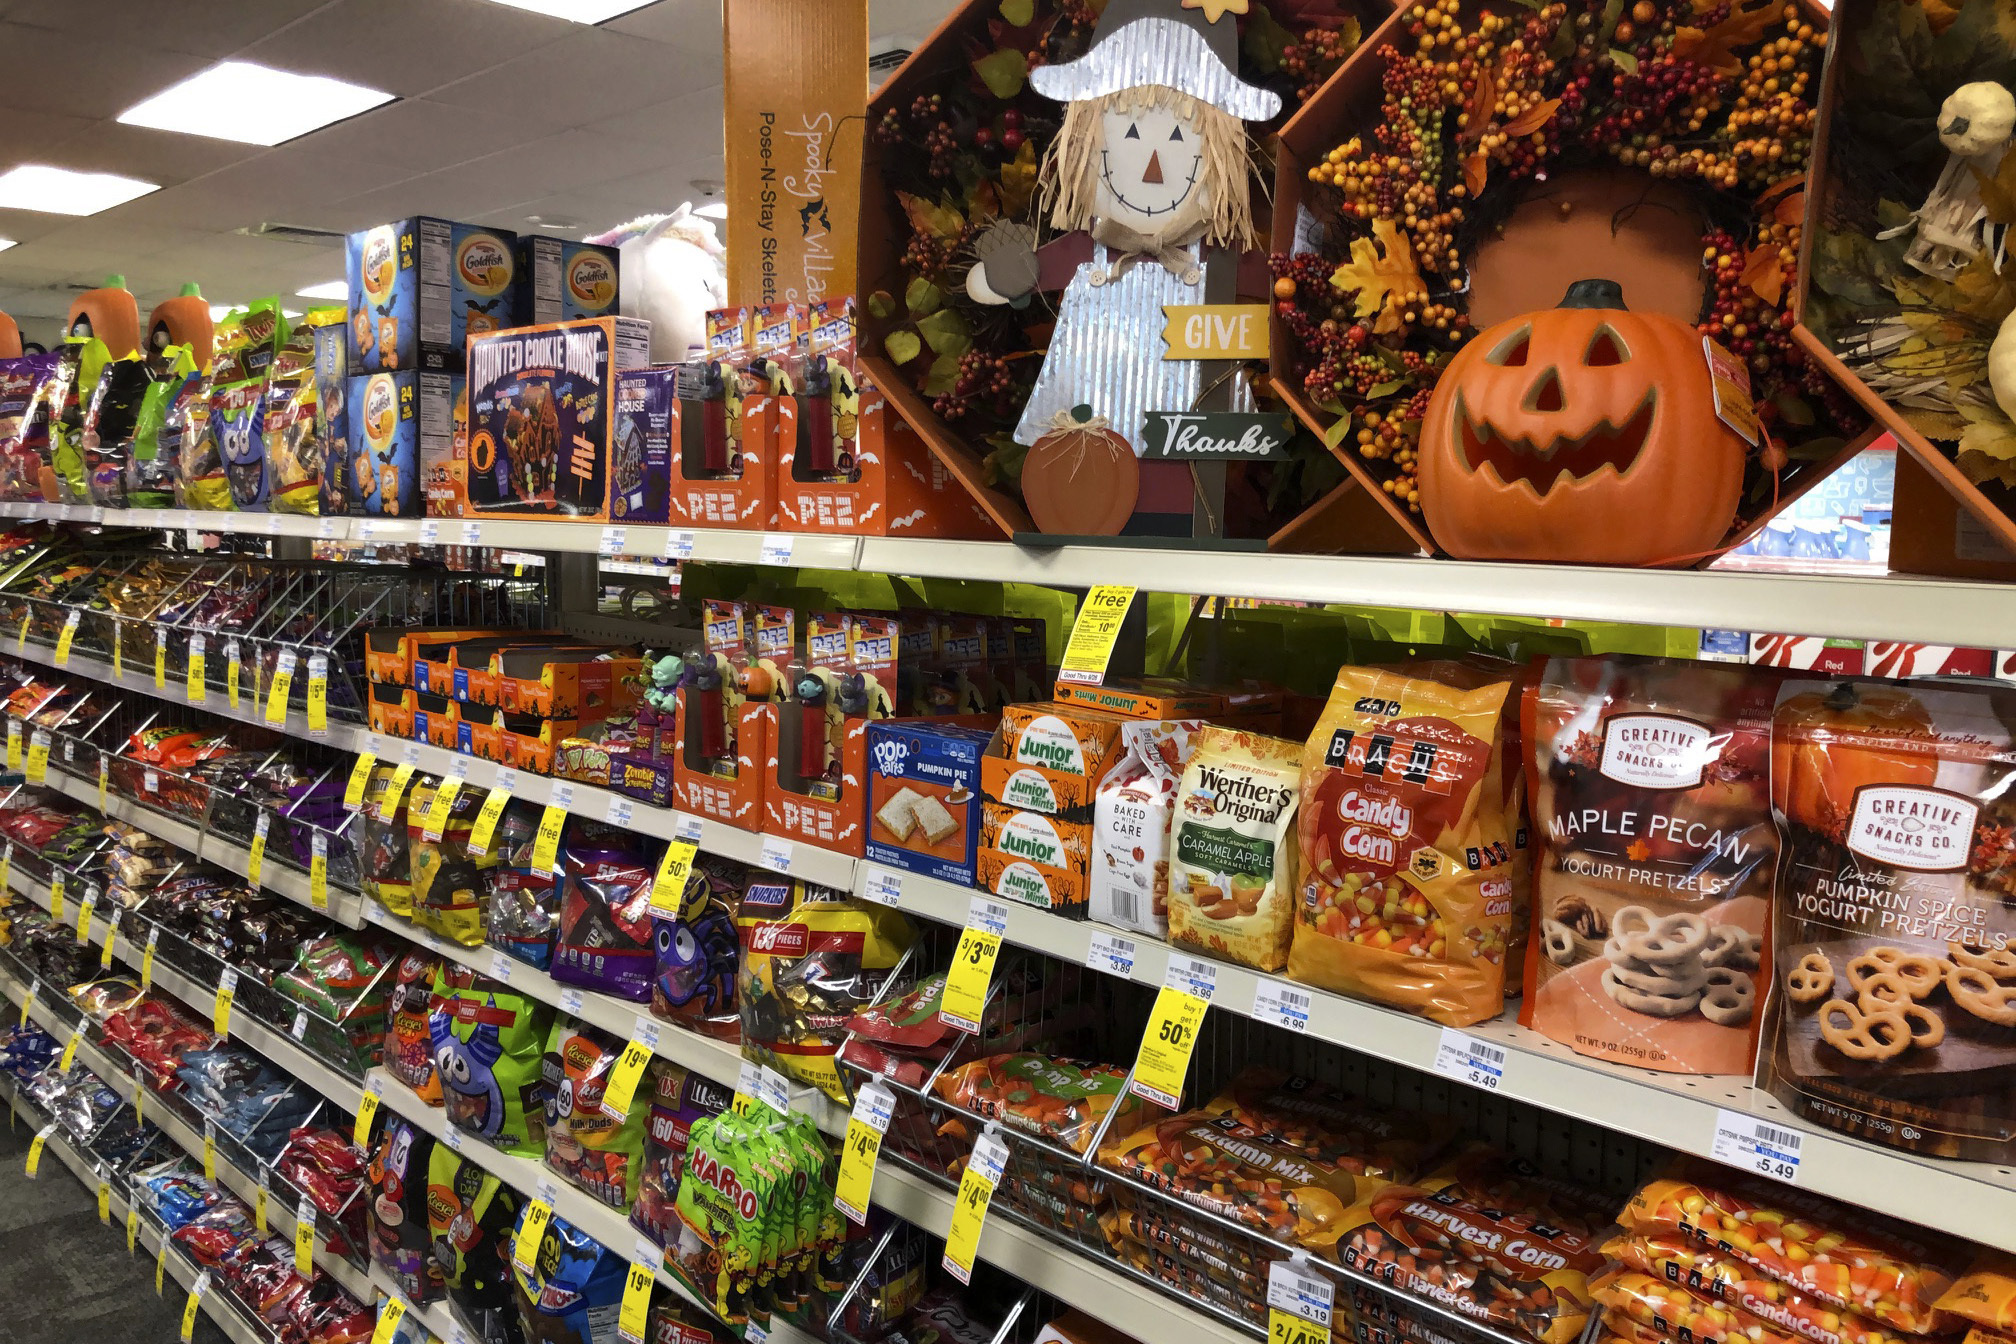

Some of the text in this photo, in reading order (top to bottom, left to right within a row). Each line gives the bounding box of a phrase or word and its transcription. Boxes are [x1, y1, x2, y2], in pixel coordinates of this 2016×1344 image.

[757, 111, 778, 232] Pose-N-Stay
[400, 234, 414, 251] 24
[465, 253, 504, 271] Goldfish
[1184, 313, 1254, 350] GIVE
[474, 332, 602, 402] HAUNTED COOKIE HOUSE
[400, 386, 414, 402] 24
[619, 378, 647, 389] HAUNTED
[618, 400, 645, 413] HOUSE
[1160, 414, 1280, 456] Thanks
[686, 490, 738, 522] PEZ
[797, 492, 855, 527] PEZ
[1092, 590, 1127, 607] free
[706, 619, 738, 642] PEZ
[756, 625, 789, 647] PEZ
[810, 632, 847, 654] PEZ
[853, 636, 892, 660] PEZ
[1825, 659, 1844, 671] Red
[1620, 728, 1696, 749] CREATIVE
[1019, 734, 1074, 766] Junior
[624, 764, 655, 783] Zombie
[916, 762, 968, 780] PUMPKIN PIE
[1010, 779, 1056, 812] Junior Mints
[1198, 763, 1292, 808] Werther's
[1364, 782, 1390, 796] Classic
[436, 790, 452, 806] free
[688, 780, 733, 819] PEZ
[1212, 793, 1283, 825] Original
[481, 804, 498, 820] free
[782, 800, 836, 841] PEZ
[1113, 804, 1146, 820] BAKED
[1120, 816, 1136, 824] WITH
[1340, 792, 1412, 836] Candy
[1872, 798, 1962, 826] CREATIVE
[539, 822, 558, 841] free
[1112, 821, 1142, 838] CARE
[1548, 808, 1751, 866] MAPLE PECAN
[1864, 822, 1956, 850] SNACKS CO.
[866, 845, 875, 858] 12
[1000, 830, 1056, 860] Junior
[1182, 834, 1272, 869] CARAMEL APPLE
[1342, 826, 1394, 863] Corn
[1194, 852, 1252, 872] SOFT CARAMELS
[1560, 856, 1723, 894] YOGURT PRETZELS
[1837, 864, 1898, 895] Limited
[745, 884, 789, 906] SNICKERS
[1004, 871, 1050, 906] Junior Mints
[1816, 877, 1988, 928] PUMPKIN SPICE
[1795, 890, 2008, 953] YOGURT PRETZELS
[776, 934, 802, 946] PIECES
[1110, 960, 1131, 974] $3.89
[1190, 984, 1212, 1000] $5.99
[1184, 1002, 1196, 1014] buy
[1180, 1016, 1192, 1024] get
[1280, 1016, 1305, 1031] $6.99
[1602, 1040, 1606, 1049] 9
[1621, 1044, 1647, 1060] (255g)
[830, 1074, 837, 1082] OZ
[1468, 1070, 1497, 1089] $5.49
[1136, 1084, 1150, 1094] Good
[1150, 1088, 1162, 1100] Thru
[569, 1118, 612, 1130] Milk Duds
[1001, 1109, 1042, 1134] Pumpkins
[1810, 1100, 1896, 1134] NET WT 9 OZ (255g)
[652, 1116, 674, 1142] 160
[1190, 1126, 1316, 1184] Autumn Mix
[1756, 1158, 1794, 1180] $5.49
[1403, 1201, 1568, 1270] Harvest Corn
[1407, 1273, 1489, 1320] Harvest Corn
[1300, 1304, 1327, 1322] $3.19
